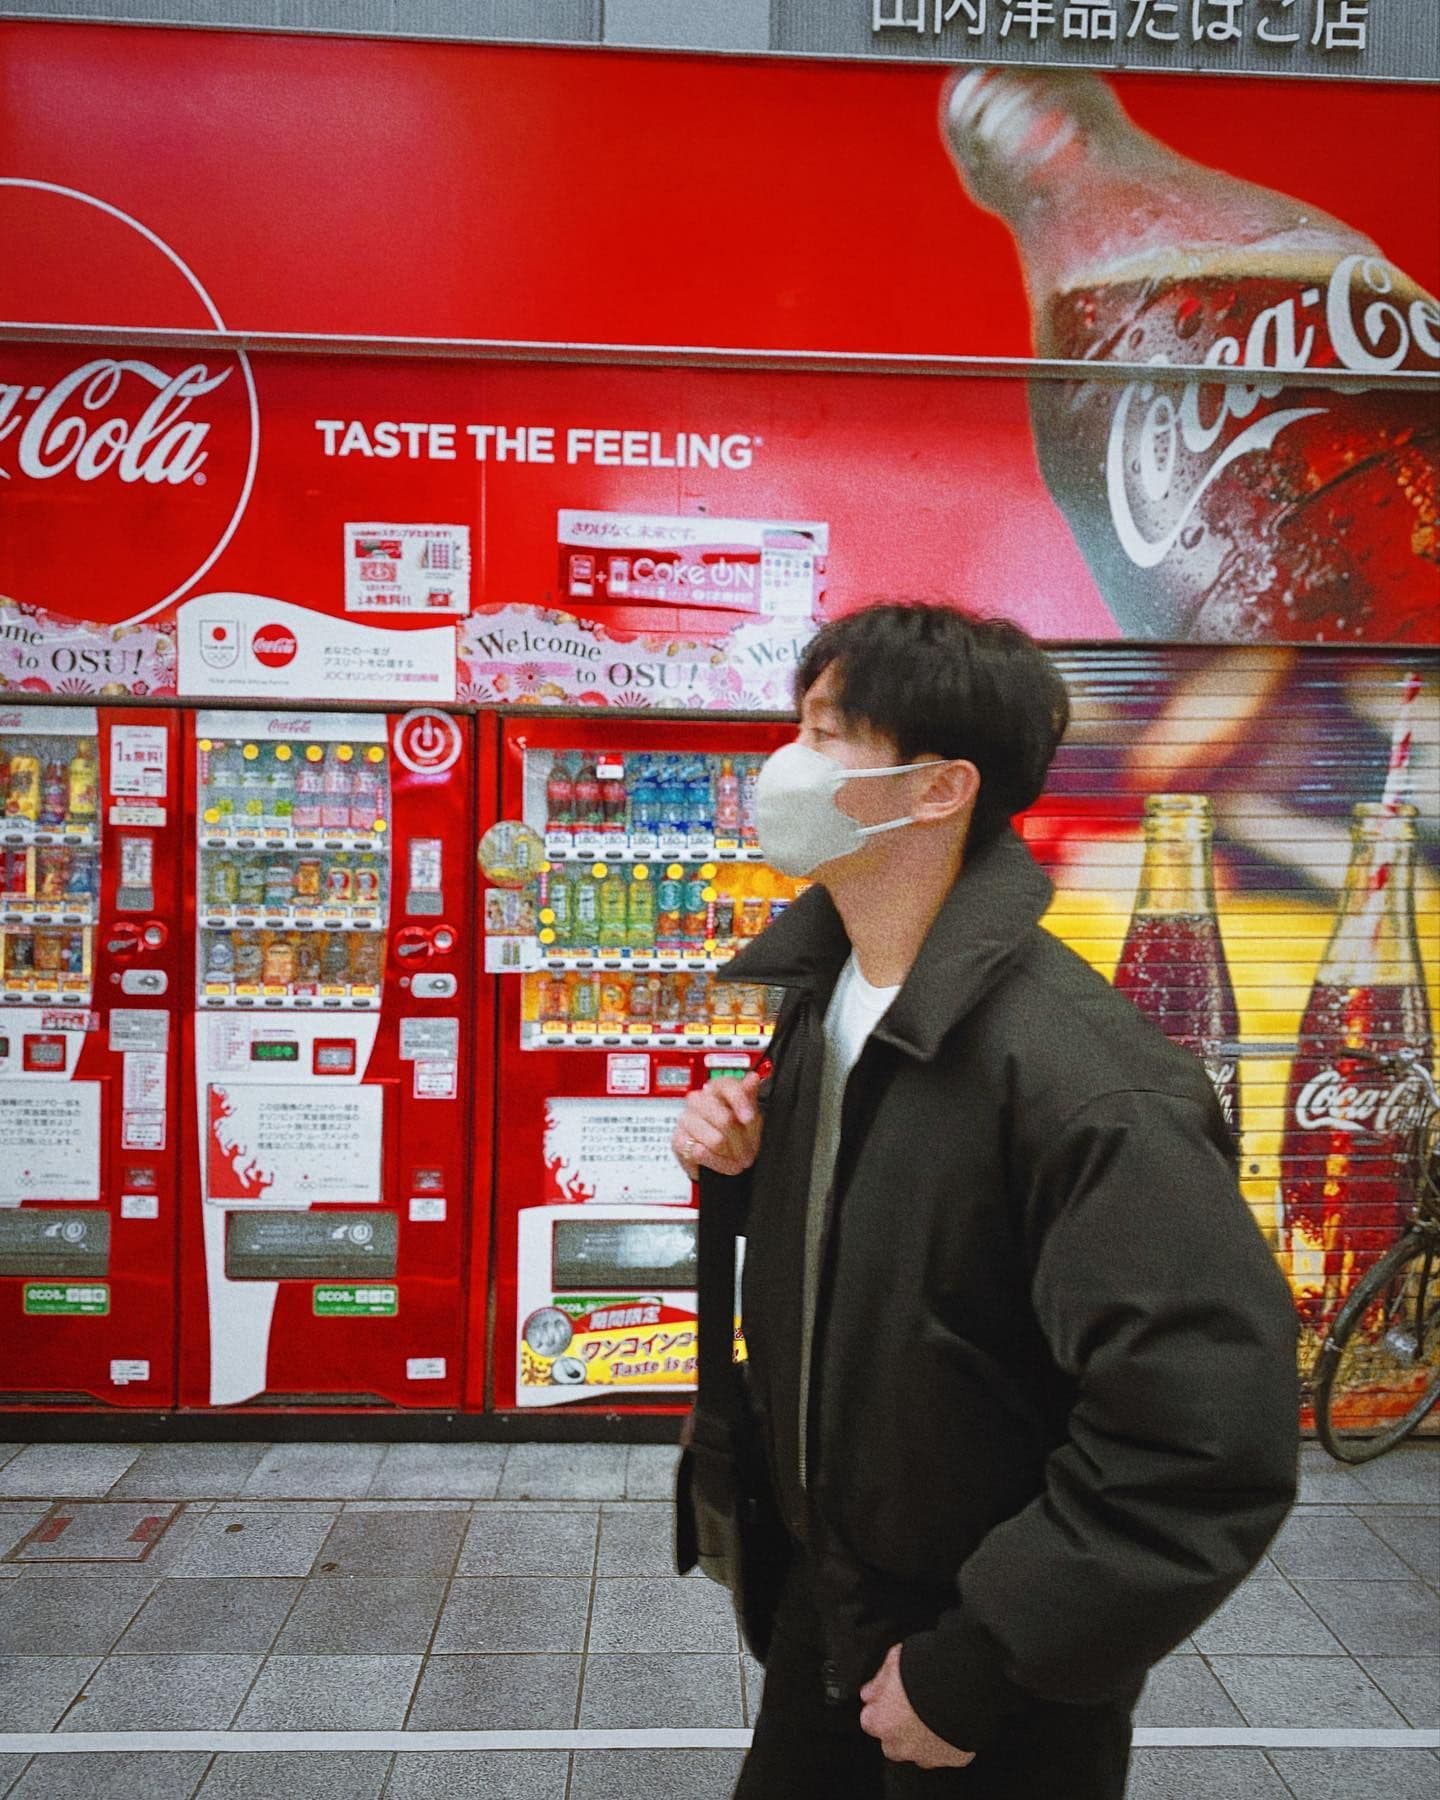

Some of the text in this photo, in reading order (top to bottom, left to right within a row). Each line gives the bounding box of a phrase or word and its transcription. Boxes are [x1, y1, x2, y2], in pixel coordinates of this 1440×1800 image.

[314, 419, 753, 470] TASTE THE FEELING
[632, 557, 705, 586] Coke
[476, 630, 603, 662] Welcome
[17, 647, 144, 675] to OSU!
[576, 661, 700, 690] to OSU!
[588, 1305, 661, 1331] 期間限定
[610, 1358, 659, 1378] Taste
[663, 1356, 681, 1372] is
